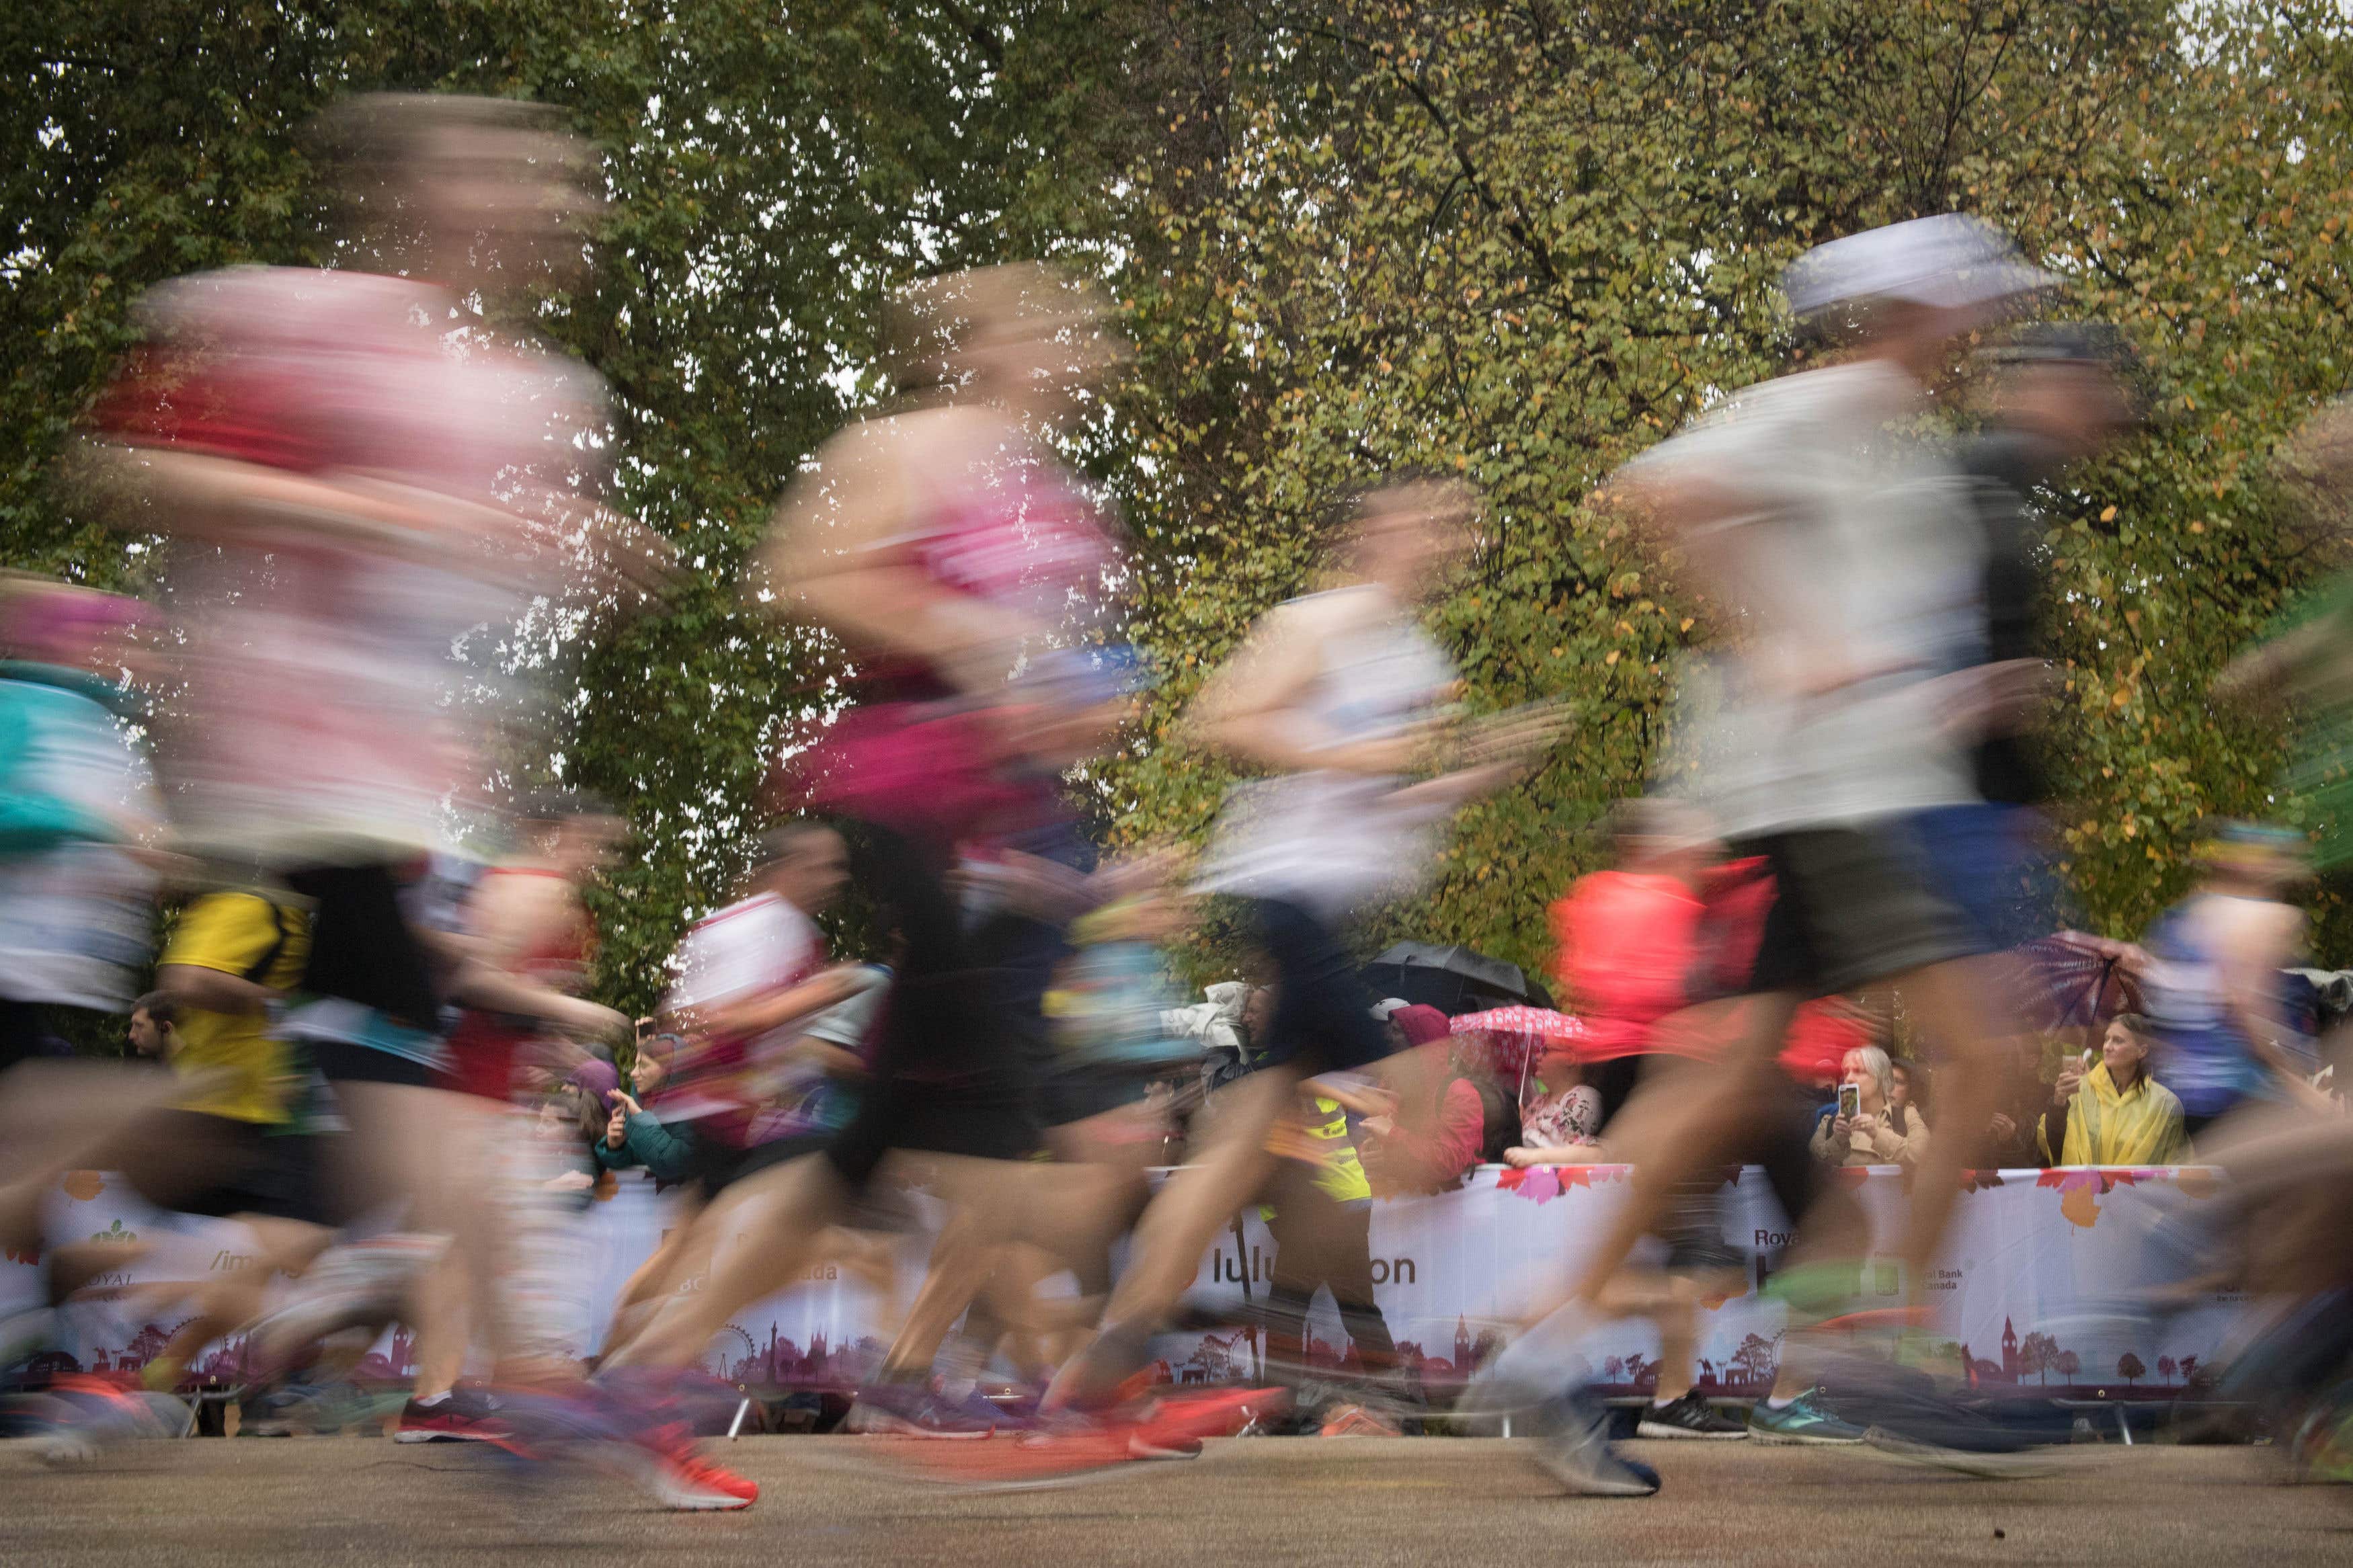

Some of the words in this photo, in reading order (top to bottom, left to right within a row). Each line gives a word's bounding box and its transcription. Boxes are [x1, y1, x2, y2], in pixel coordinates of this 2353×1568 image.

[1754, 1229, 1800, 1247] Roya
[1214, 1245, 1415, 1284] luluon
[1938, 1268, 1963, 1279] Bank
[1923, 1280, 1957, 1290] Canada
